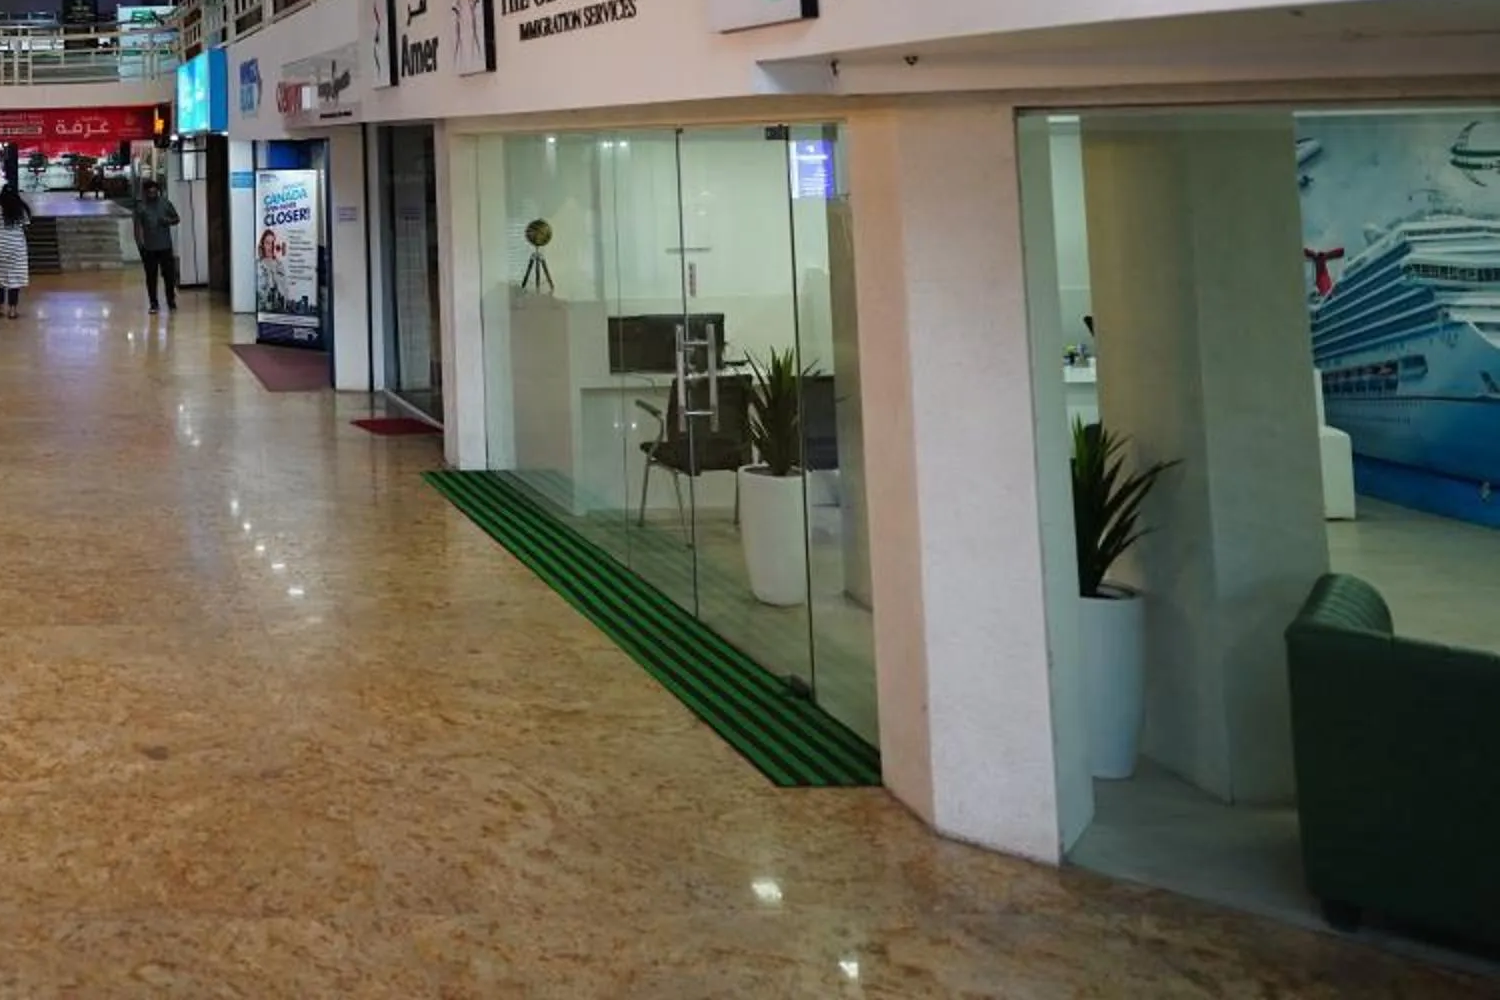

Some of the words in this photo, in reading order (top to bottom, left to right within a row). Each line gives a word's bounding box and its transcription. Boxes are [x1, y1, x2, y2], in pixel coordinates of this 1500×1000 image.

[518, 3, 582, 42] IMMIGRATION
[401, 34, 439, 77] Amer
[263, 187, 308, 206] CANADA
[263, 207, 311, 227] CLOSER!
